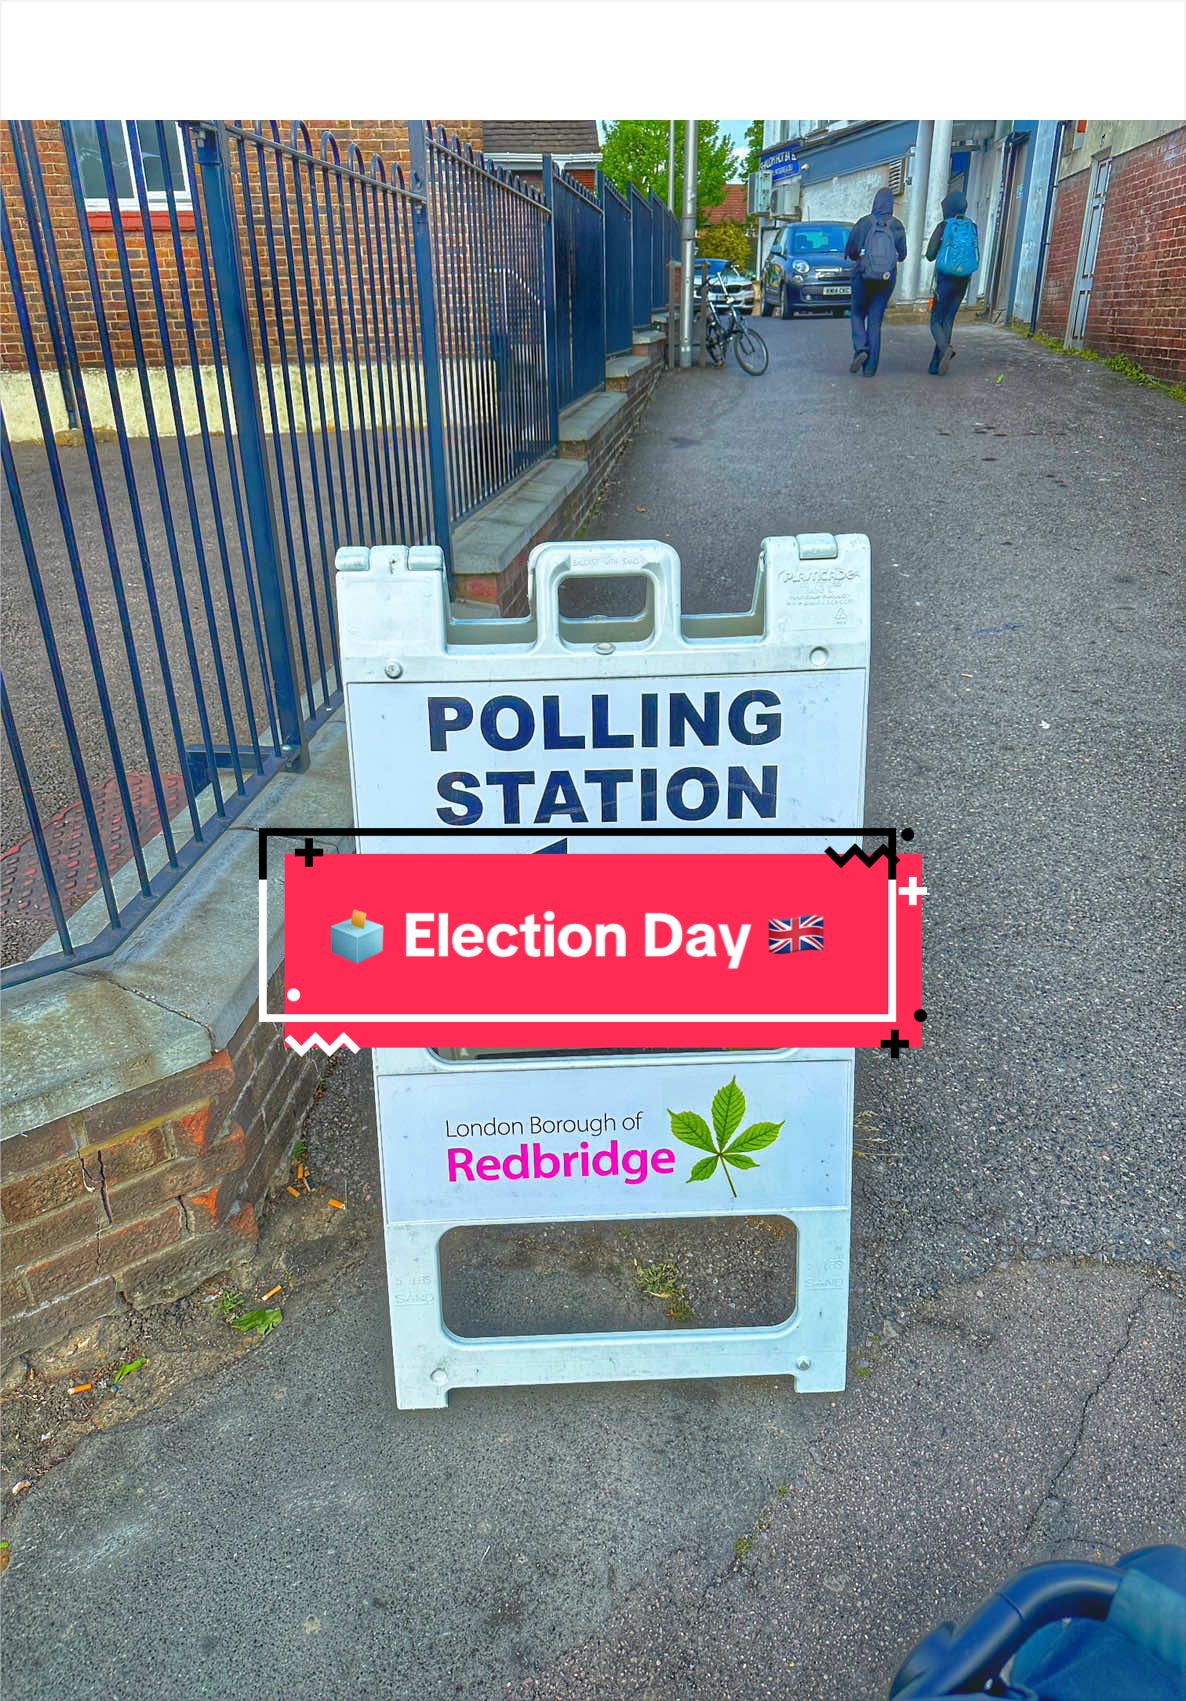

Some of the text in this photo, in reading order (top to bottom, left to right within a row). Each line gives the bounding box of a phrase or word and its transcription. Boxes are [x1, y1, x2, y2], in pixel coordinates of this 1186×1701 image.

[428, 688, 783, 753] POLLING
[436, 765, 779, 826] STATION
[445, 1110, 644, 1138] London Borough of
[447, 1138, 677, 1185] Redbridge
